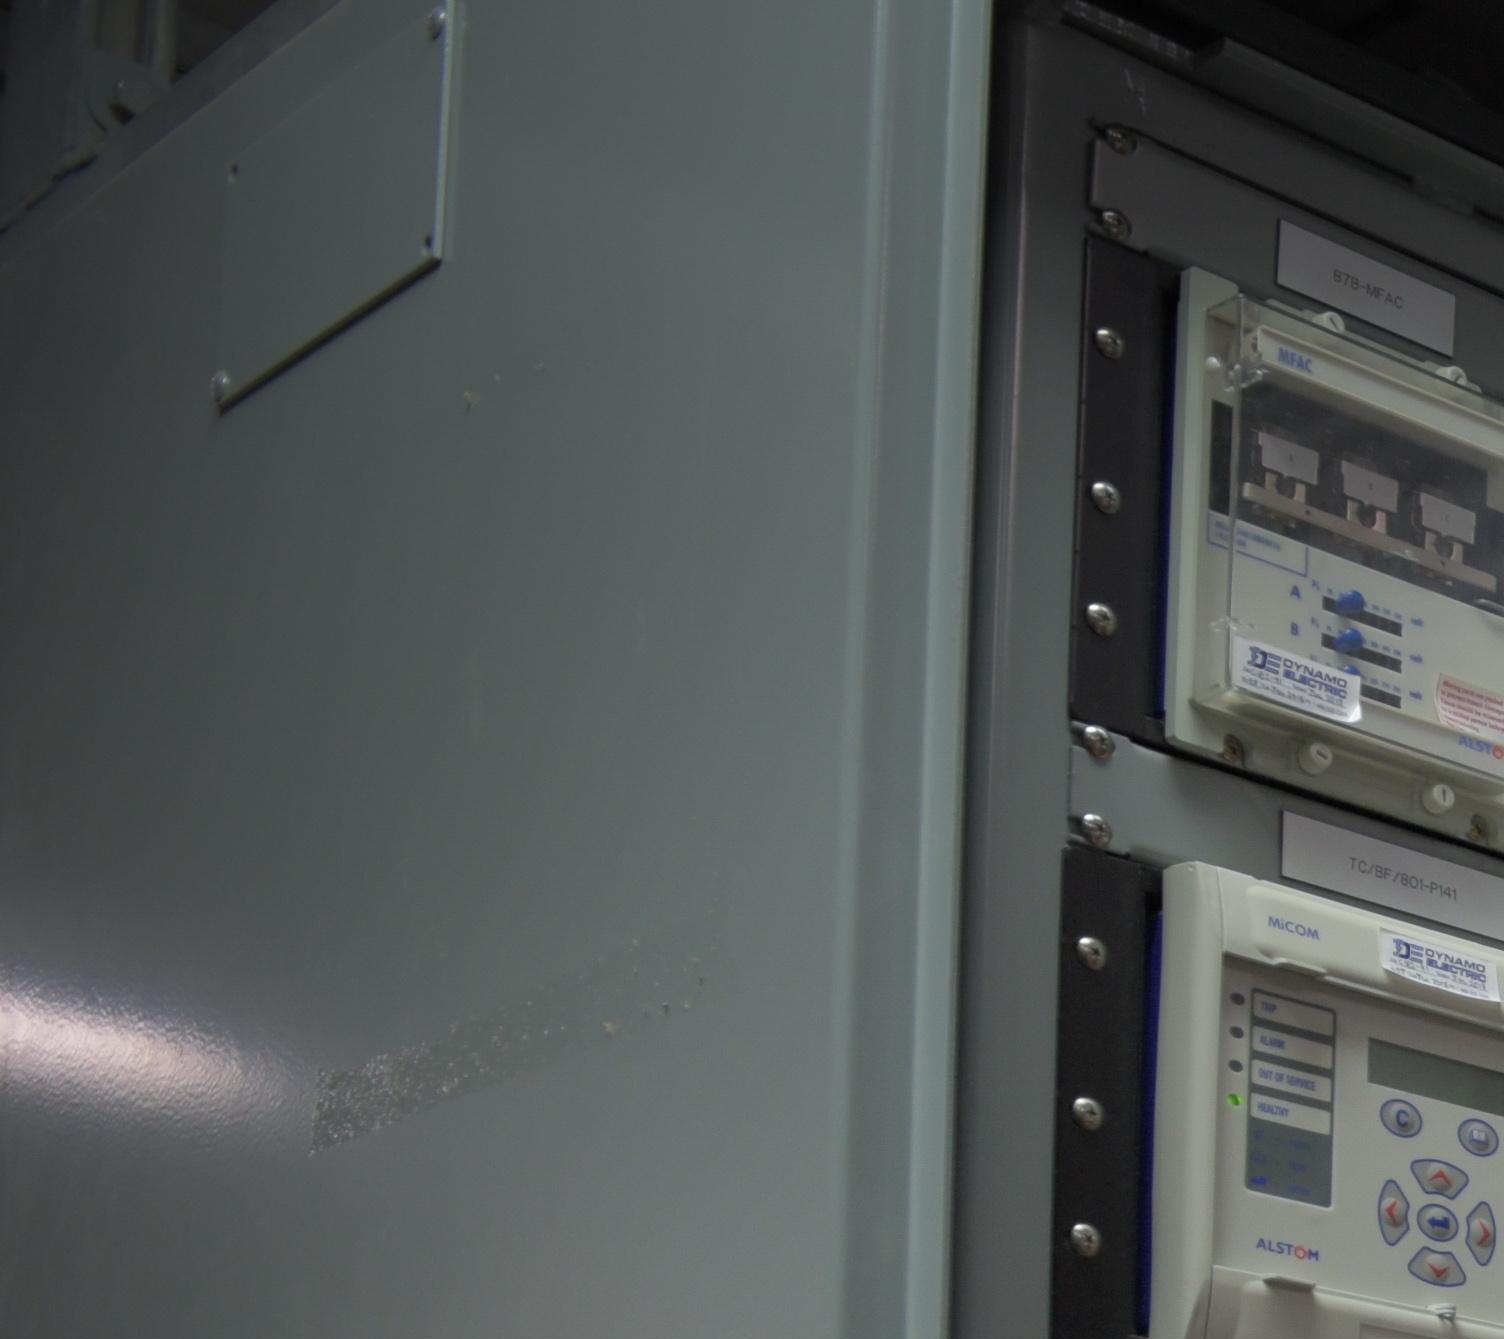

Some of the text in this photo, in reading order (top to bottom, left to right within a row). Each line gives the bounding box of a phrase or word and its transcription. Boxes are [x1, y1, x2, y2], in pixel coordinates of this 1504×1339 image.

[1332, 268, 1406, 311] 87B-MFAC
[1277, 347, 1314, 375] MFAC
[1282, 657, 1348, 690] DYNAMO
[1282, 668, 1348, 700] ELECTRIC
[1346, 854, 1461, 904] TC/BF/801-P141
[1266, 913, 1322, 943] MiCOM
[1425, 947, 1487, 974] DYNAMO
[1425, 957, 1488, 984] ELECTRIC
[1260, 1001, 1279, 1014] TRIP
[1258, 1034, 1286, 1050] ALARM
[1257, 1067, 1317, 1092] OUT OF SERVICE
[1256, 1101, 1290, 1119] HEALTHY
[1395, 1108, 1410, 1129] C
[1254, 1237, 1320, 1263] ALSTOM
